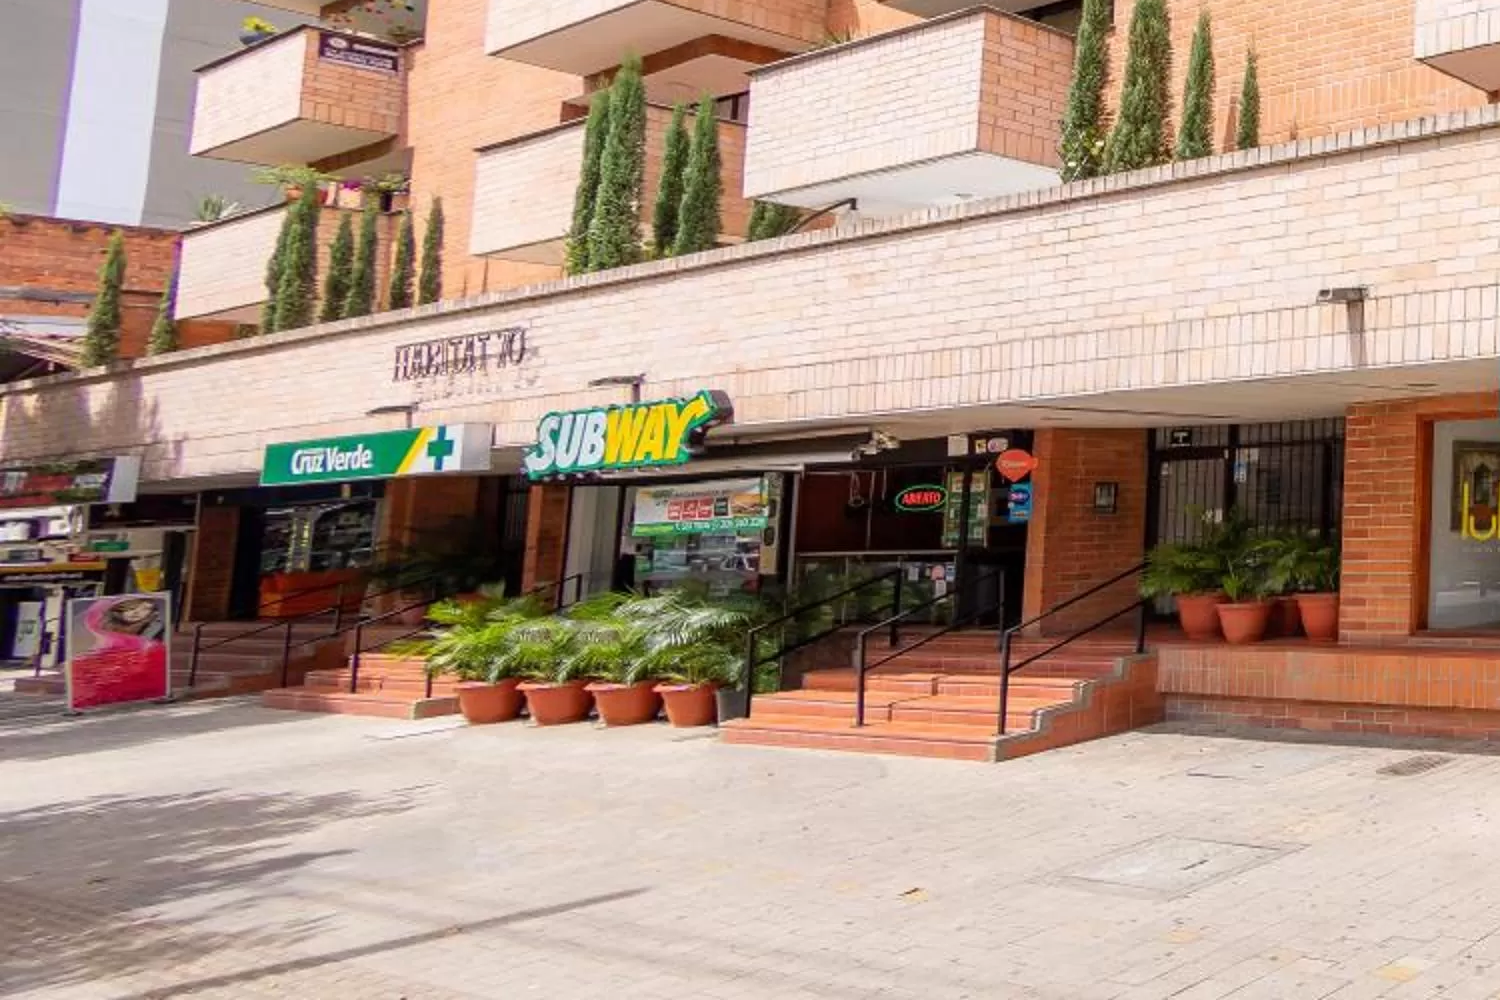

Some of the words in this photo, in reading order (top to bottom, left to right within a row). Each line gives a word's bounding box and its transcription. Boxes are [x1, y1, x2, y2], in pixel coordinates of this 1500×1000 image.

[291, 449, 326, 475] Cruz
[325, 443, 374, 473] Verde
[525, 394, 711, 472] SUBWAY
